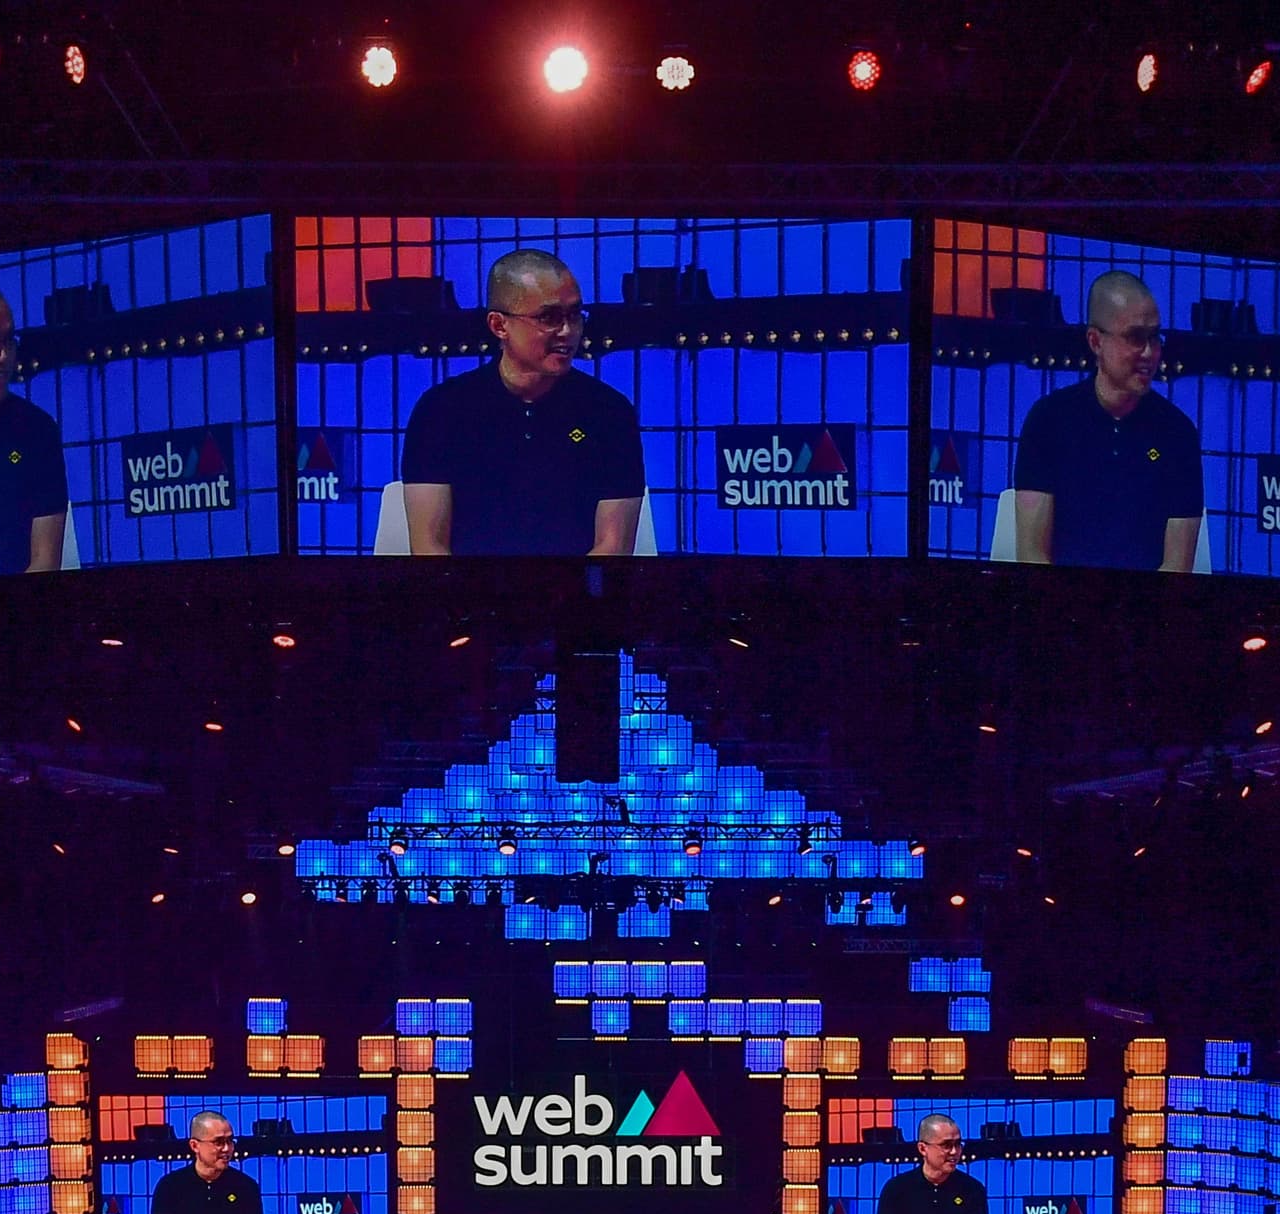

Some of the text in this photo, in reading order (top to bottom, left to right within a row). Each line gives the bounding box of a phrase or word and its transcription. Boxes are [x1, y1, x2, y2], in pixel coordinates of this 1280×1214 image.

[127, 440, 183, 483] web
[723, 434, 793, 473] web
[129, 474, 230, 513] summit
[724, 474, 850, 506] summit
[472, 1073, 614, 1137] web
[473, 1135, 723, 1187] summit
